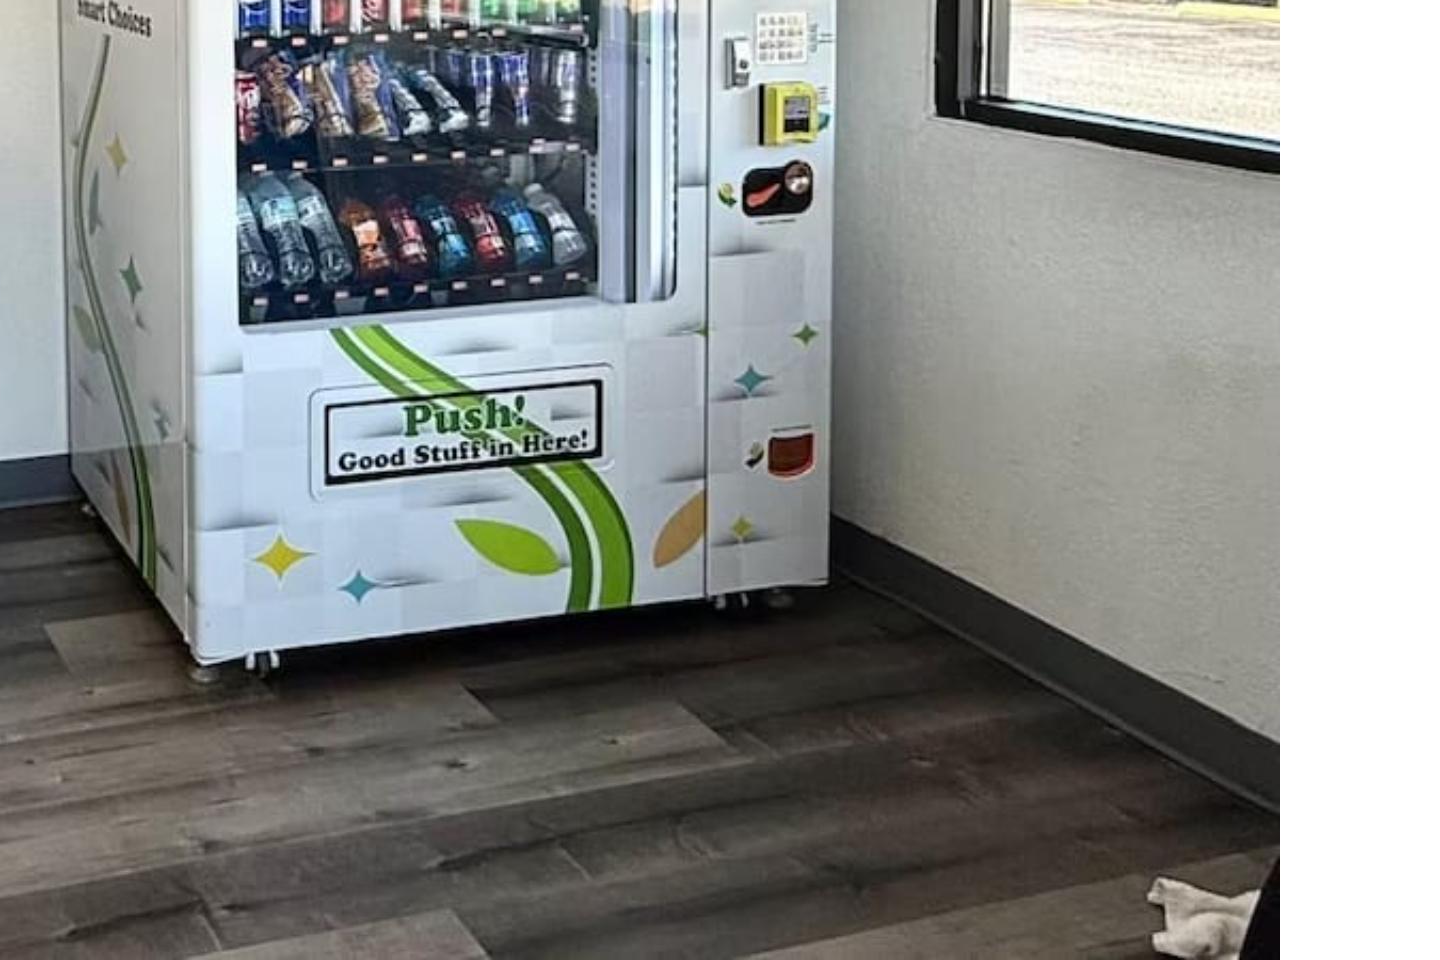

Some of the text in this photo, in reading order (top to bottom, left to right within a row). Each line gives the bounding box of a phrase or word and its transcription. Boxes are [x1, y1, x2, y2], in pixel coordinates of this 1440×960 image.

[403, 394, 526, 437] Push!
[338, 430, 588, 472] Good Stuff in Here!
